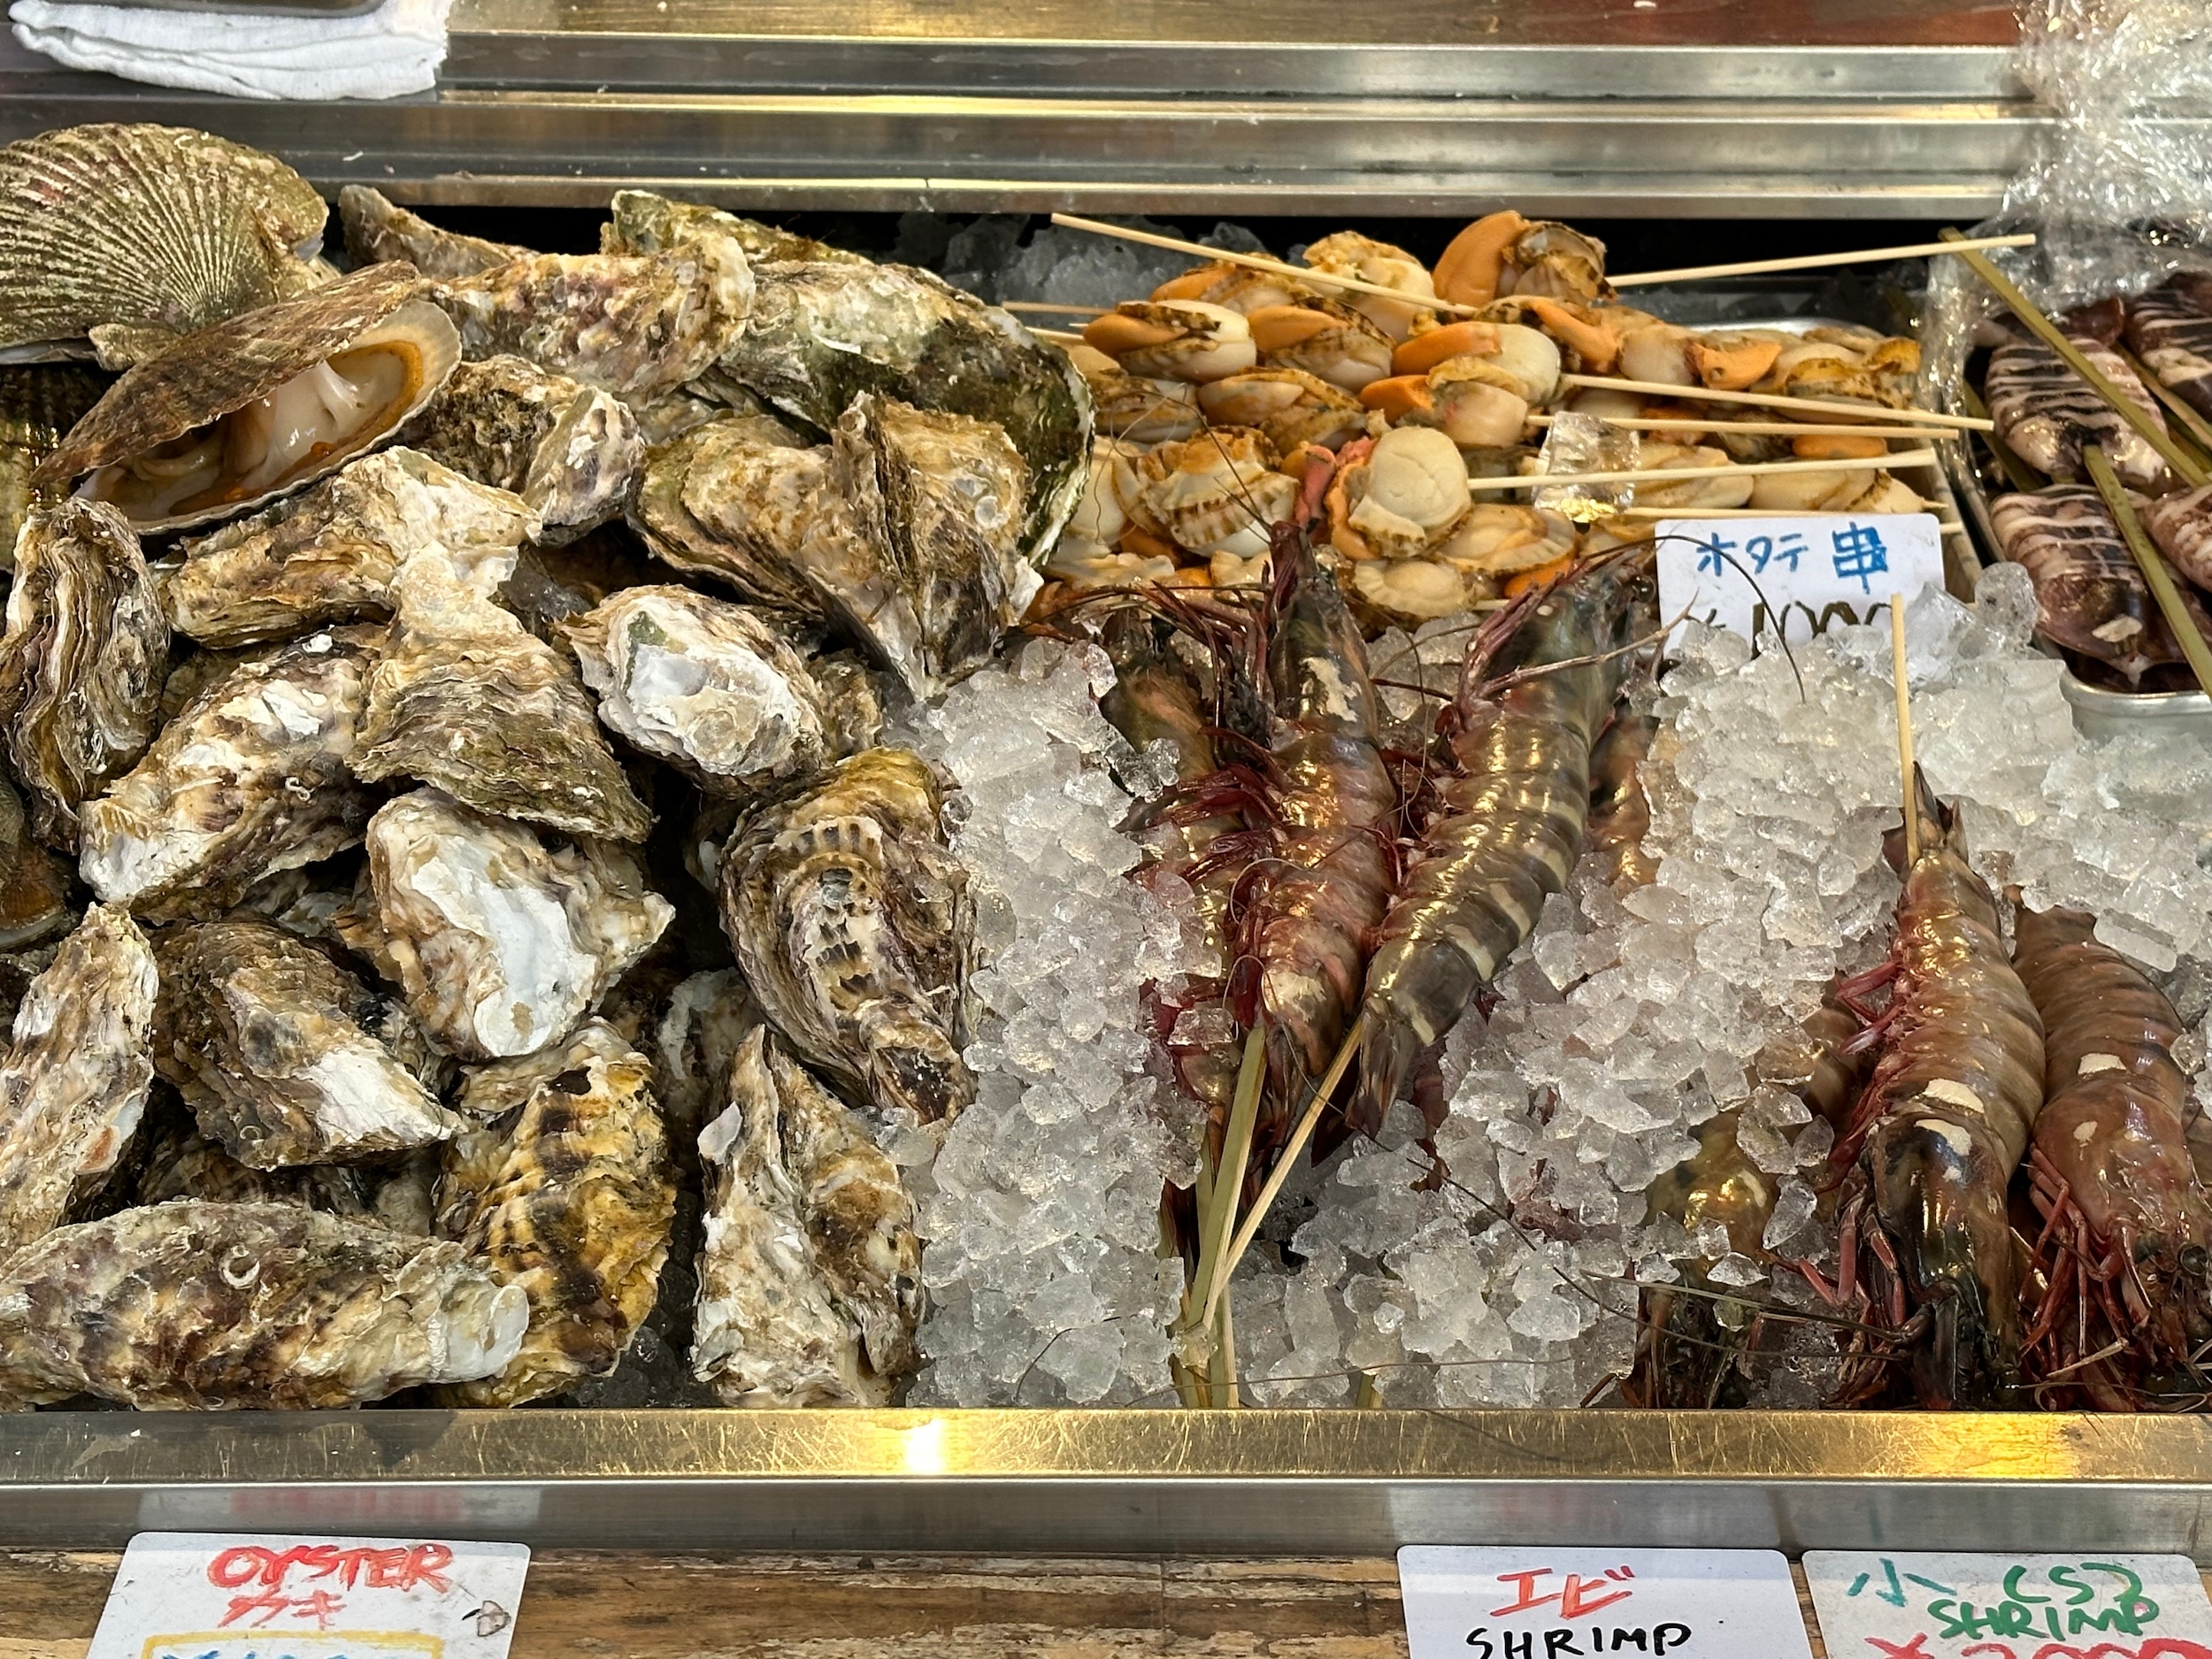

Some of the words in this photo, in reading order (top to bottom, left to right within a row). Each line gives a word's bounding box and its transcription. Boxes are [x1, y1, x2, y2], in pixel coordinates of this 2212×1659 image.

[1832, 521, 1888, 595] 串
[207, 1543, 454, 1594] OYSTER
[1489, 1565, 1635, 1619] エビ
[1847, 1558, 1956, 1607] 小
[1465, 1623, 1692, 1659] SHRIMP
[1927, 1598, 2160, 1640] SHRIMP
